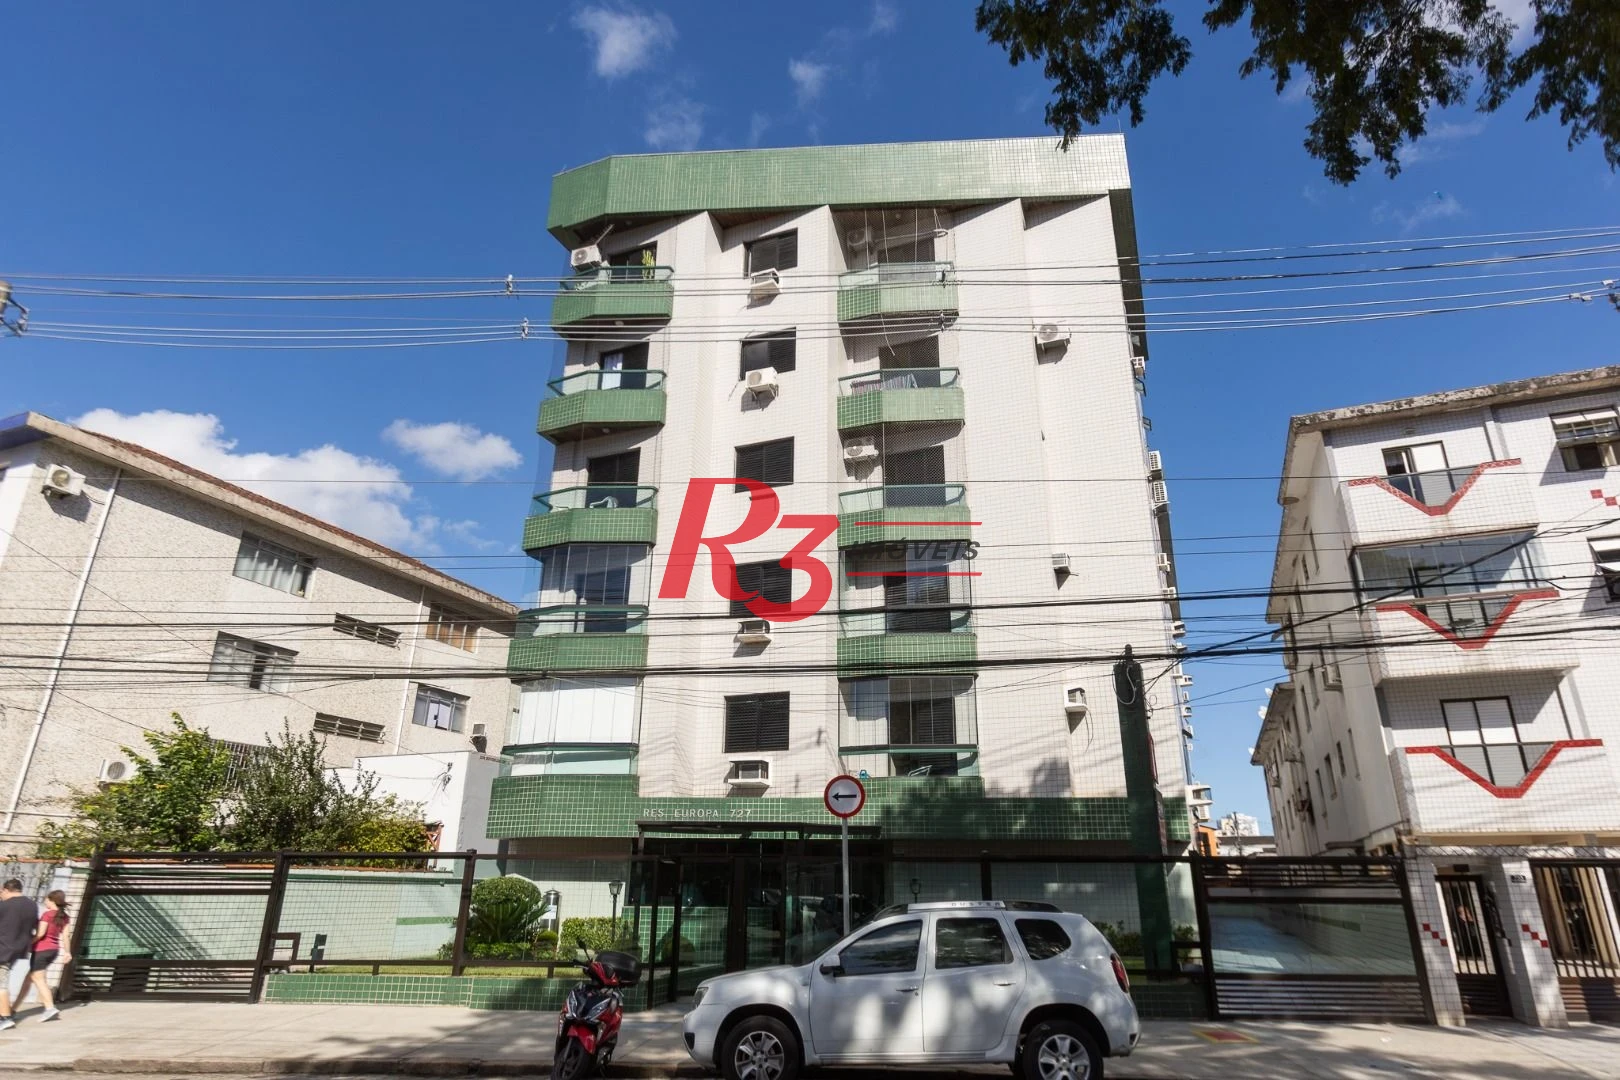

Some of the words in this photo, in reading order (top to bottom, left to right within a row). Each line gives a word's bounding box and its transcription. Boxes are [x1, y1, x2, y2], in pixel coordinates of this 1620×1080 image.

[643, 808, 665, 818] RES
[674, 808, 719, 818] EUROPA
[730, 809, 752, 818] 727
